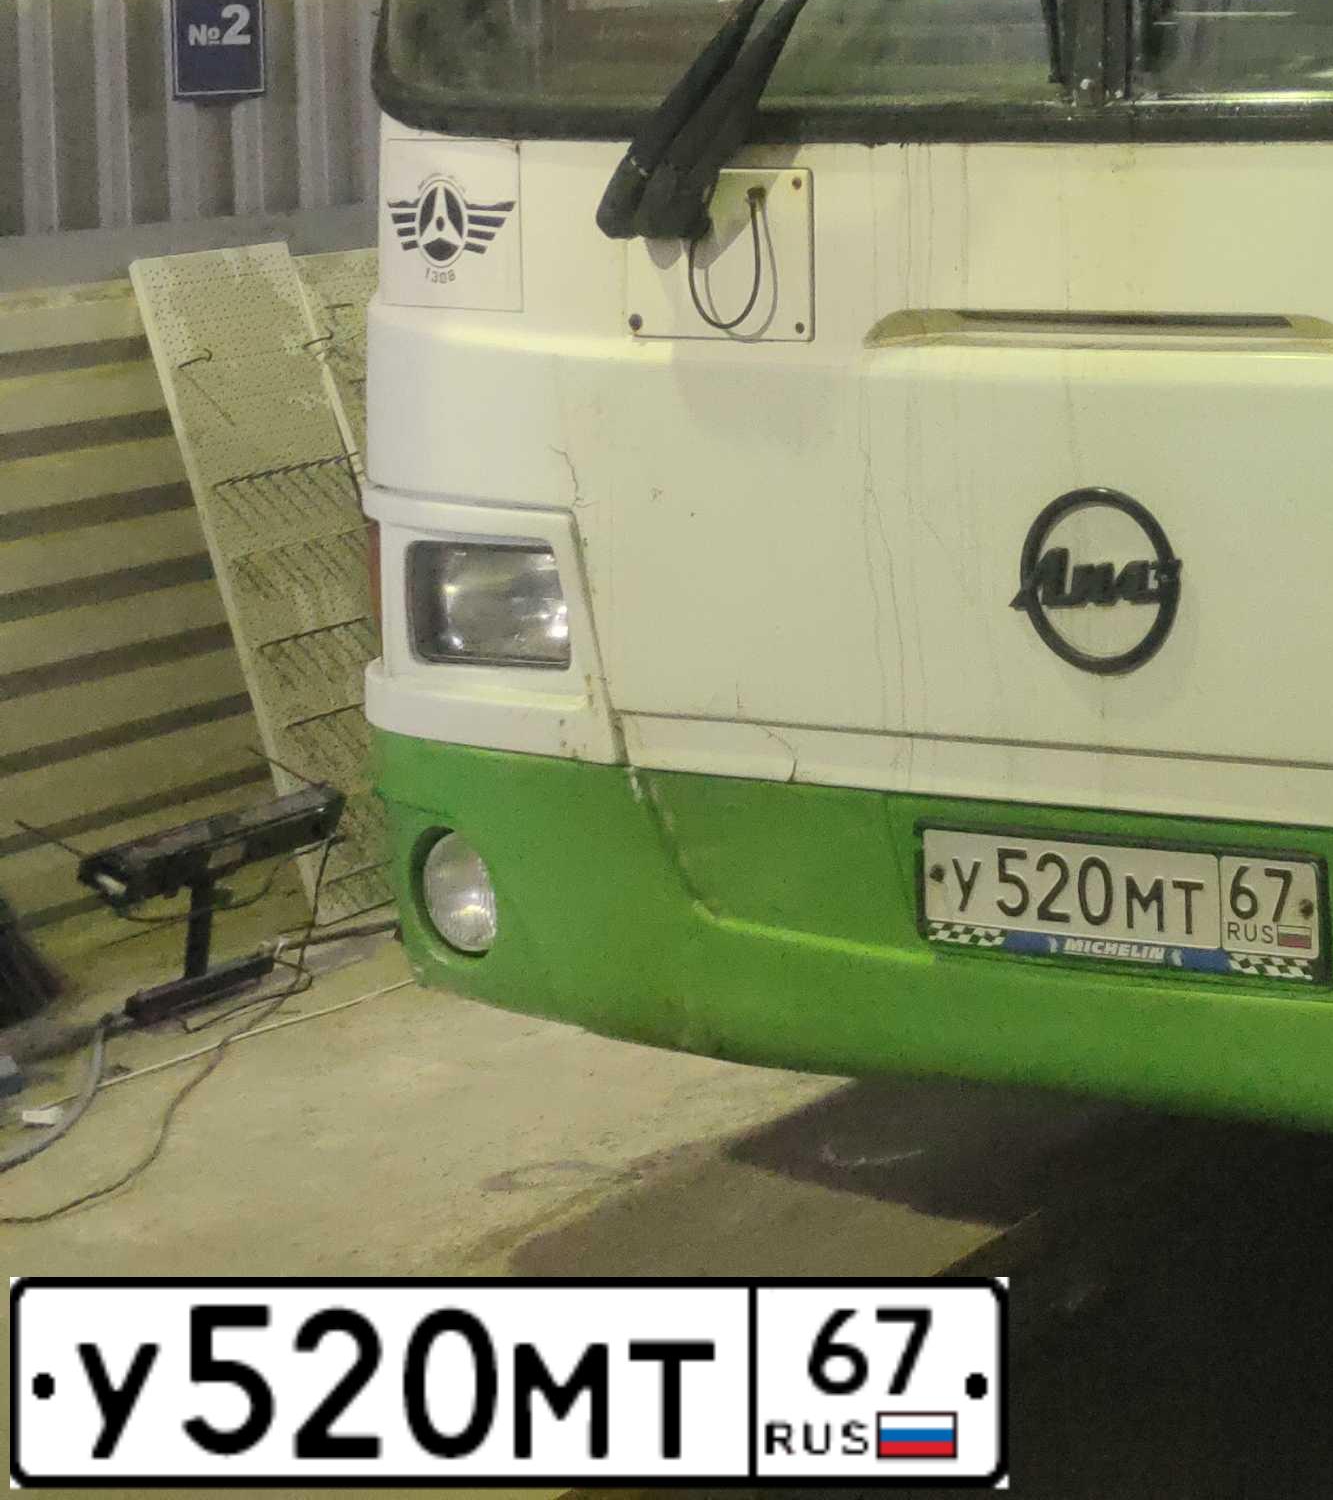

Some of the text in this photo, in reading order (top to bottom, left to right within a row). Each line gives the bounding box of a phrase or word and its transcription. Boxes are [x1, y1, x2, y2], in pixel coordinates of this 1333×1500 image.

[952, 847, 1293, 935] У520МТ 67
[1227, 922, 1274, 944] RUS
[1064, 938, 1165, 959] MICHELIN
